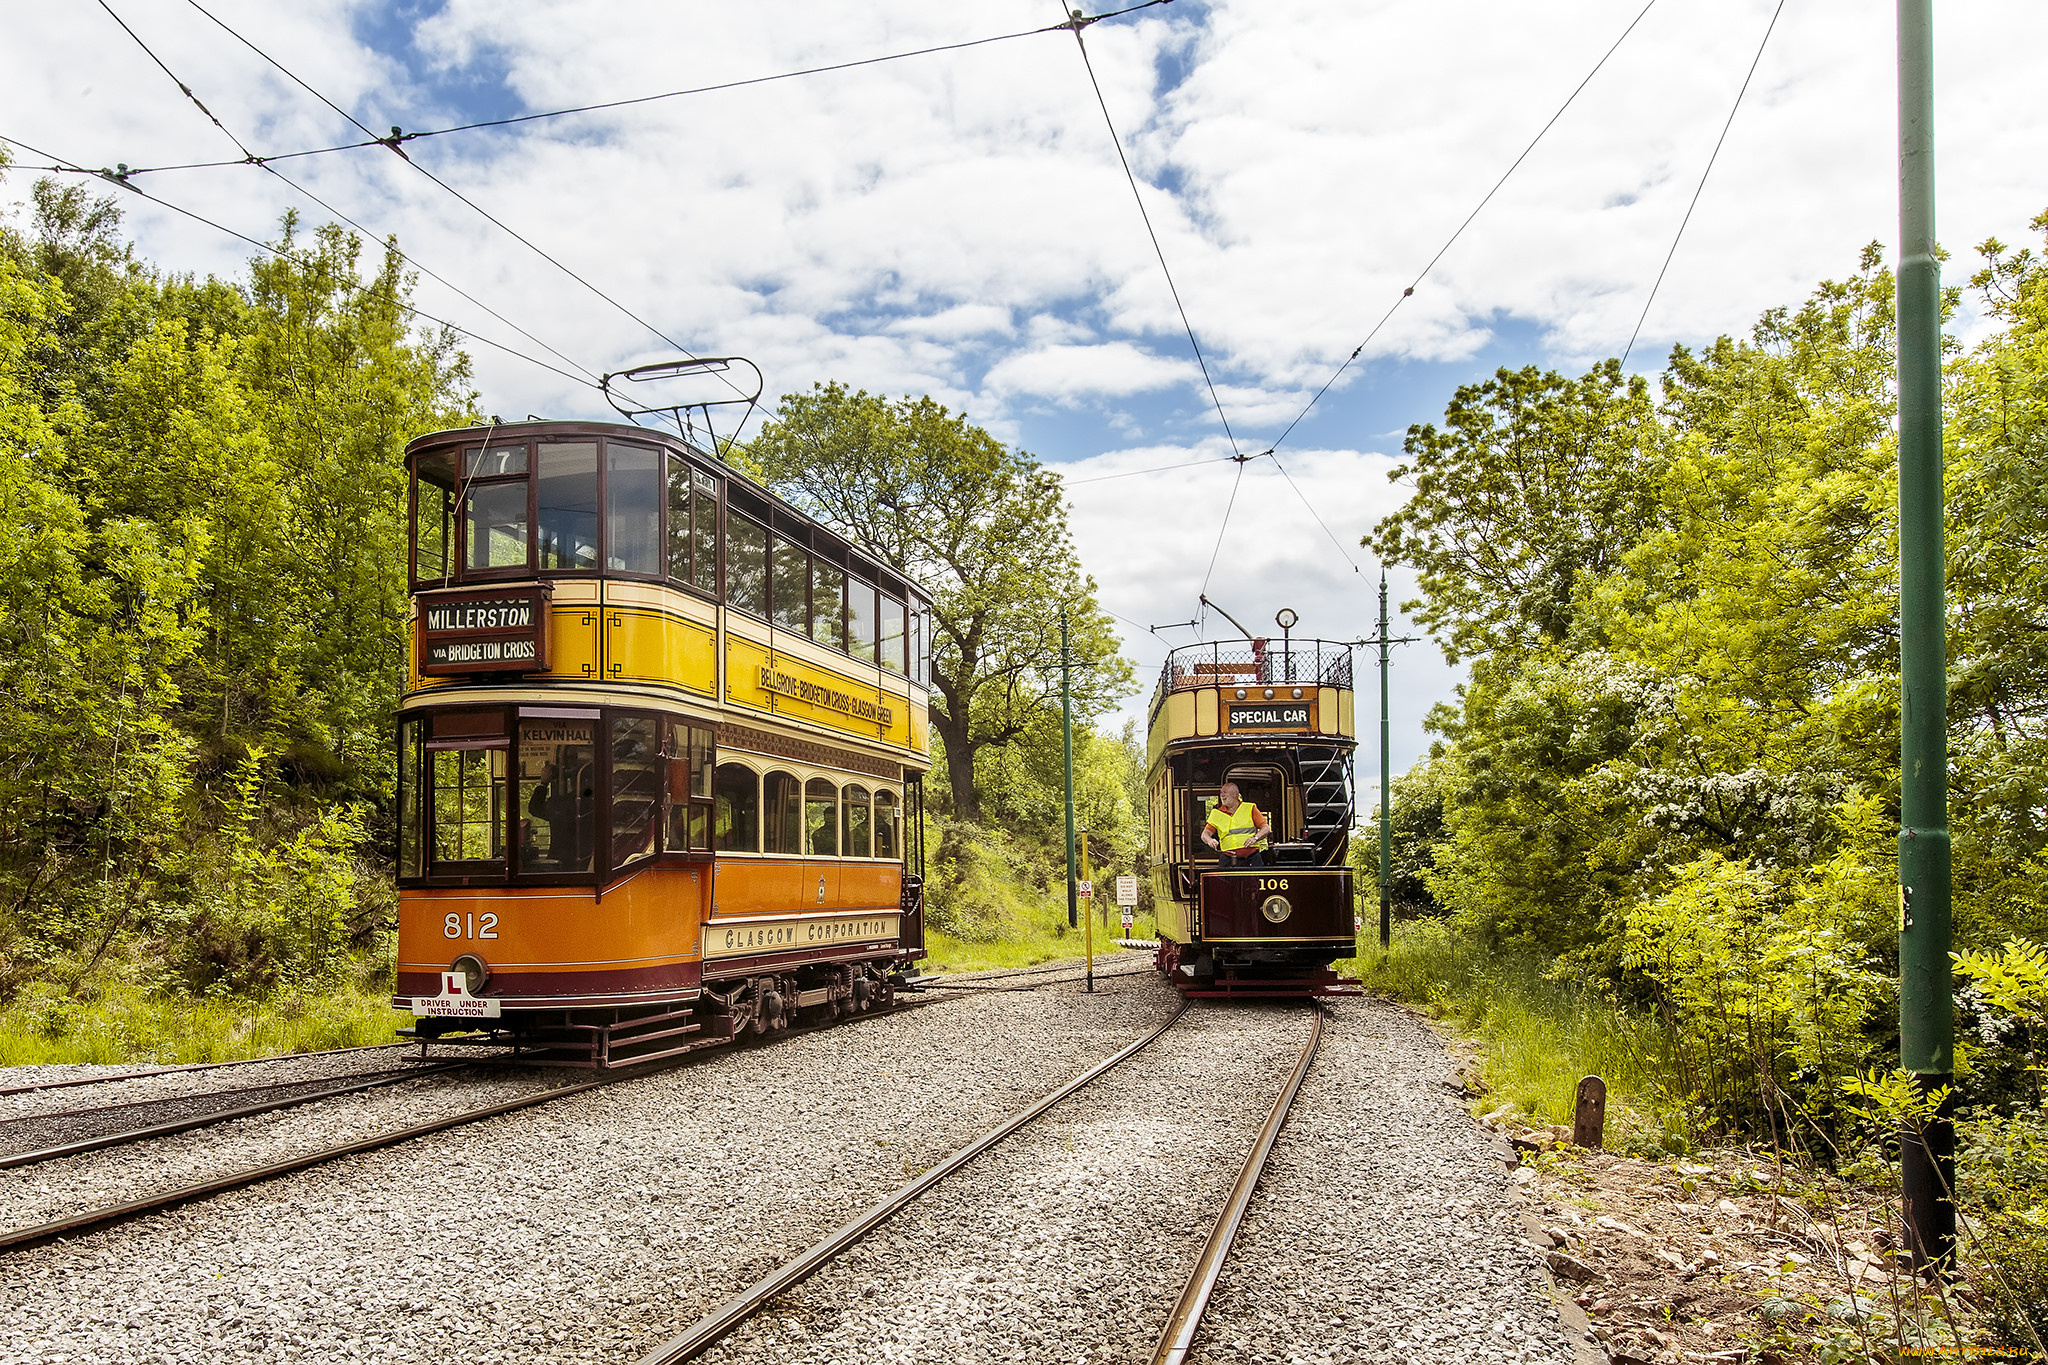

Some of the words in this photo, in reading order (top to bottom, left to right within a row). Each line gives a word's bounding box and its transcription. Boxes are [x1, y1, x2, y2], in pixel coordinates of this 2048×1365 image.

[496, 451, 510, 474] 7
[428, 607, 530, 630] MILLERSTON
[433, 648, 447, 658] VIA
[448, 642, 501, 661] BRIDGETON
[503, 640, 535, 659] CROSS
[877, 705, 892, 724] GREEN
[1230, 710, 1281, 724] SPECIAL
[1283, 709, 1307, 722] CAR
[523, 729, 565, 740] KELVIN
[1258, 878, 1289, 891] 106
[442, 912, 499, 939] 812
[725, 927, 793, 948] GLASGOW
[808, 920, 887, 941] CORPORATION
[446, 975, 462, 994] L
[421, 999, 451, 1008] DRIVER
[459, 1000, 488, 1008] UNDER
[427, 1007, 484, 1016] INSTRUCTION
